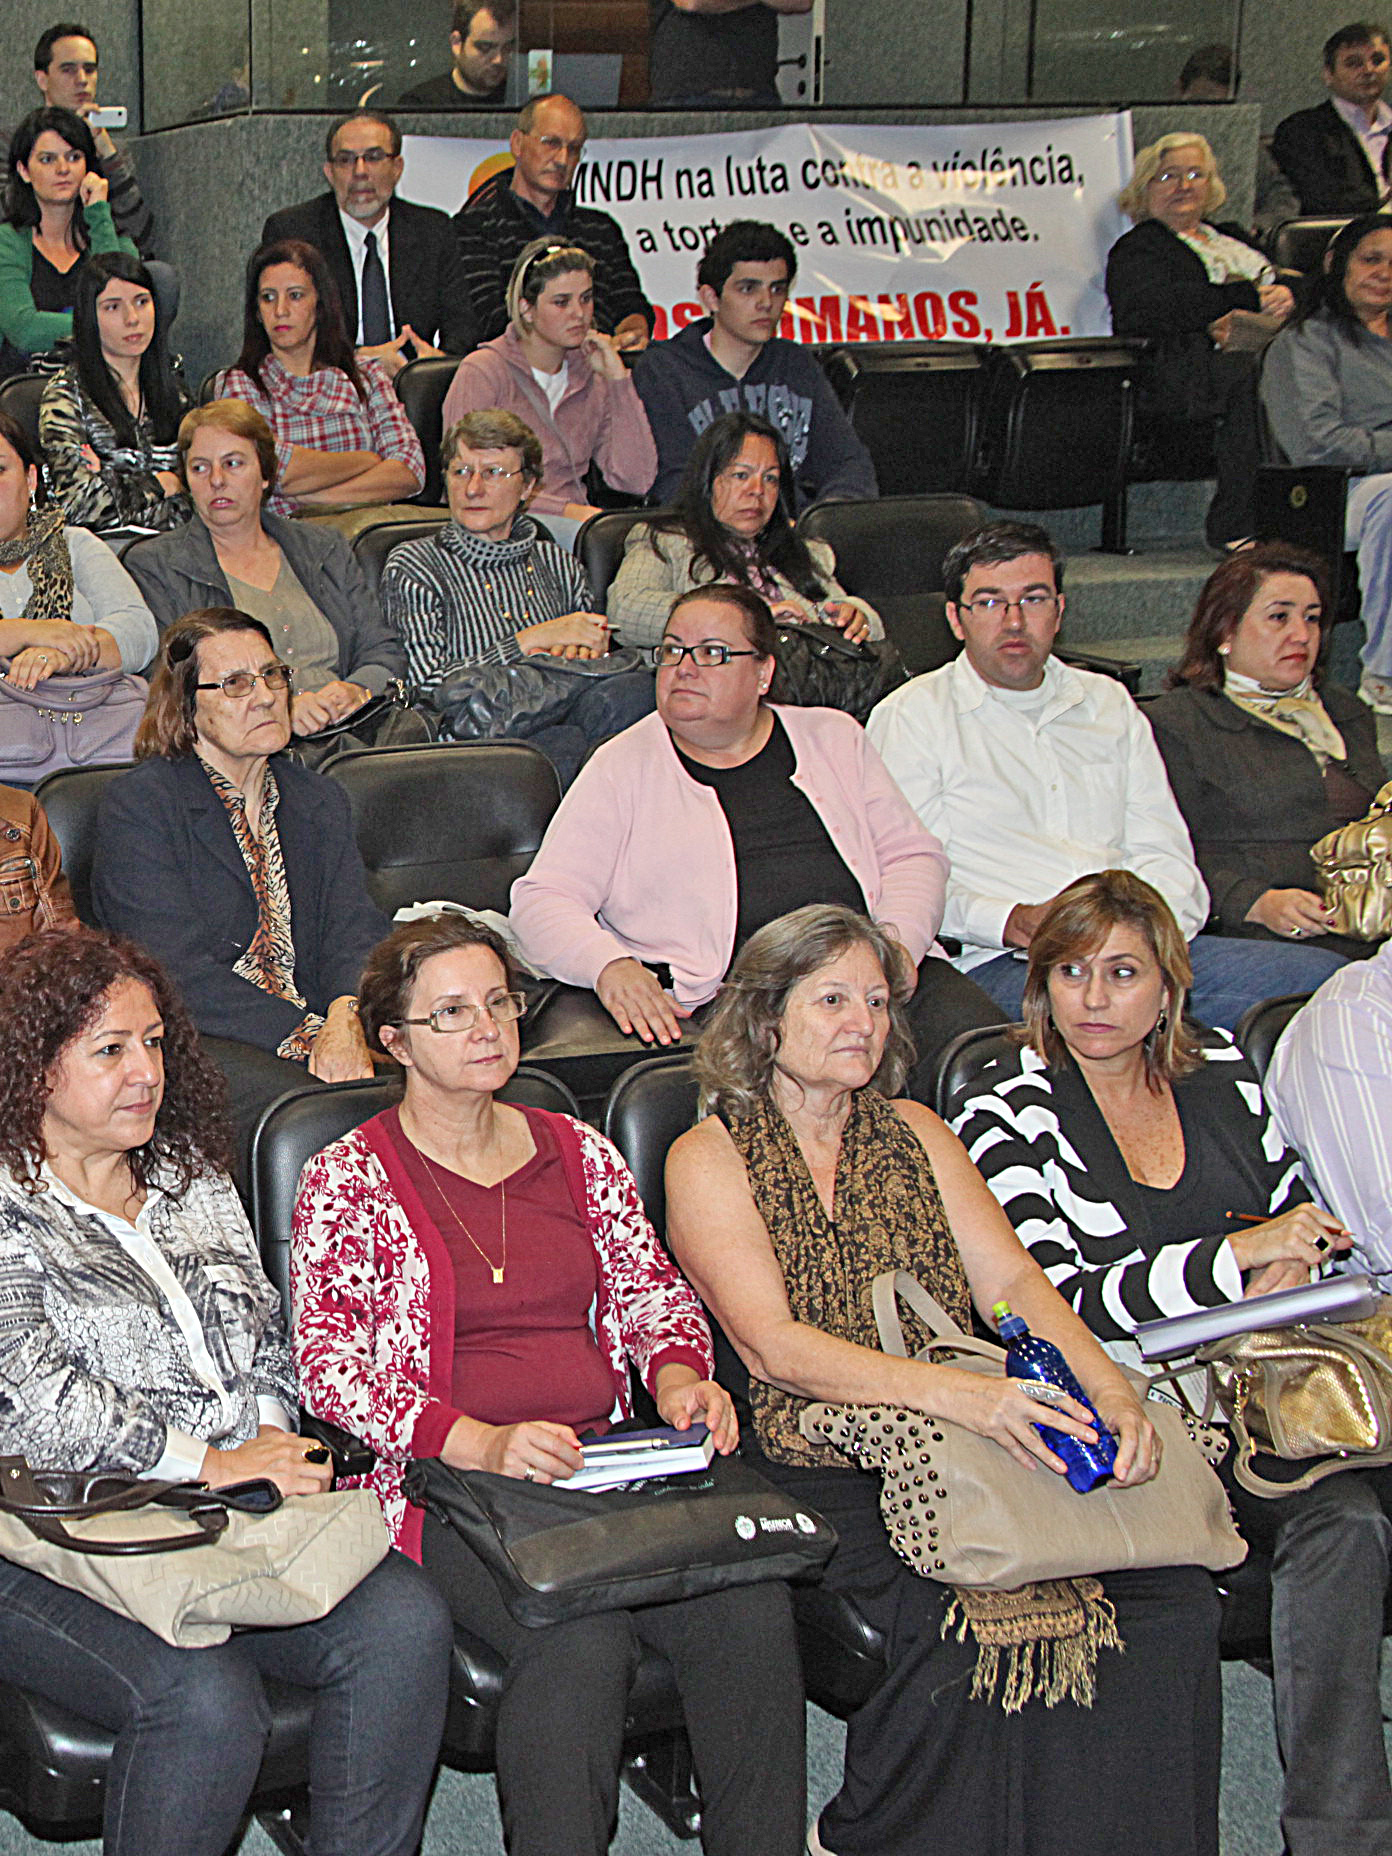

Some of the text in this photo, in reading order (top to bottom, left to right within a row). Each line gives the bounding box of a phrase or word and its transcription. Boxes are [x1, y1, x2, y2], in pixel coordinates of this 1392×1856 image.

[675, 166, 715, 200] na
[726, 154, 790, 197] luta
[800, 155, 899, 191] contra
[907, 160, 925, 190] a
[932, 143, 1085, 190] violência,
[636, 227, 658, 253] a
[789, 222, 811, 246] e
[817, 220, 840, 246] a
[844, 207, 1040, 254] impunidade.
[1004, 280, 1072, 339] JÁ.
